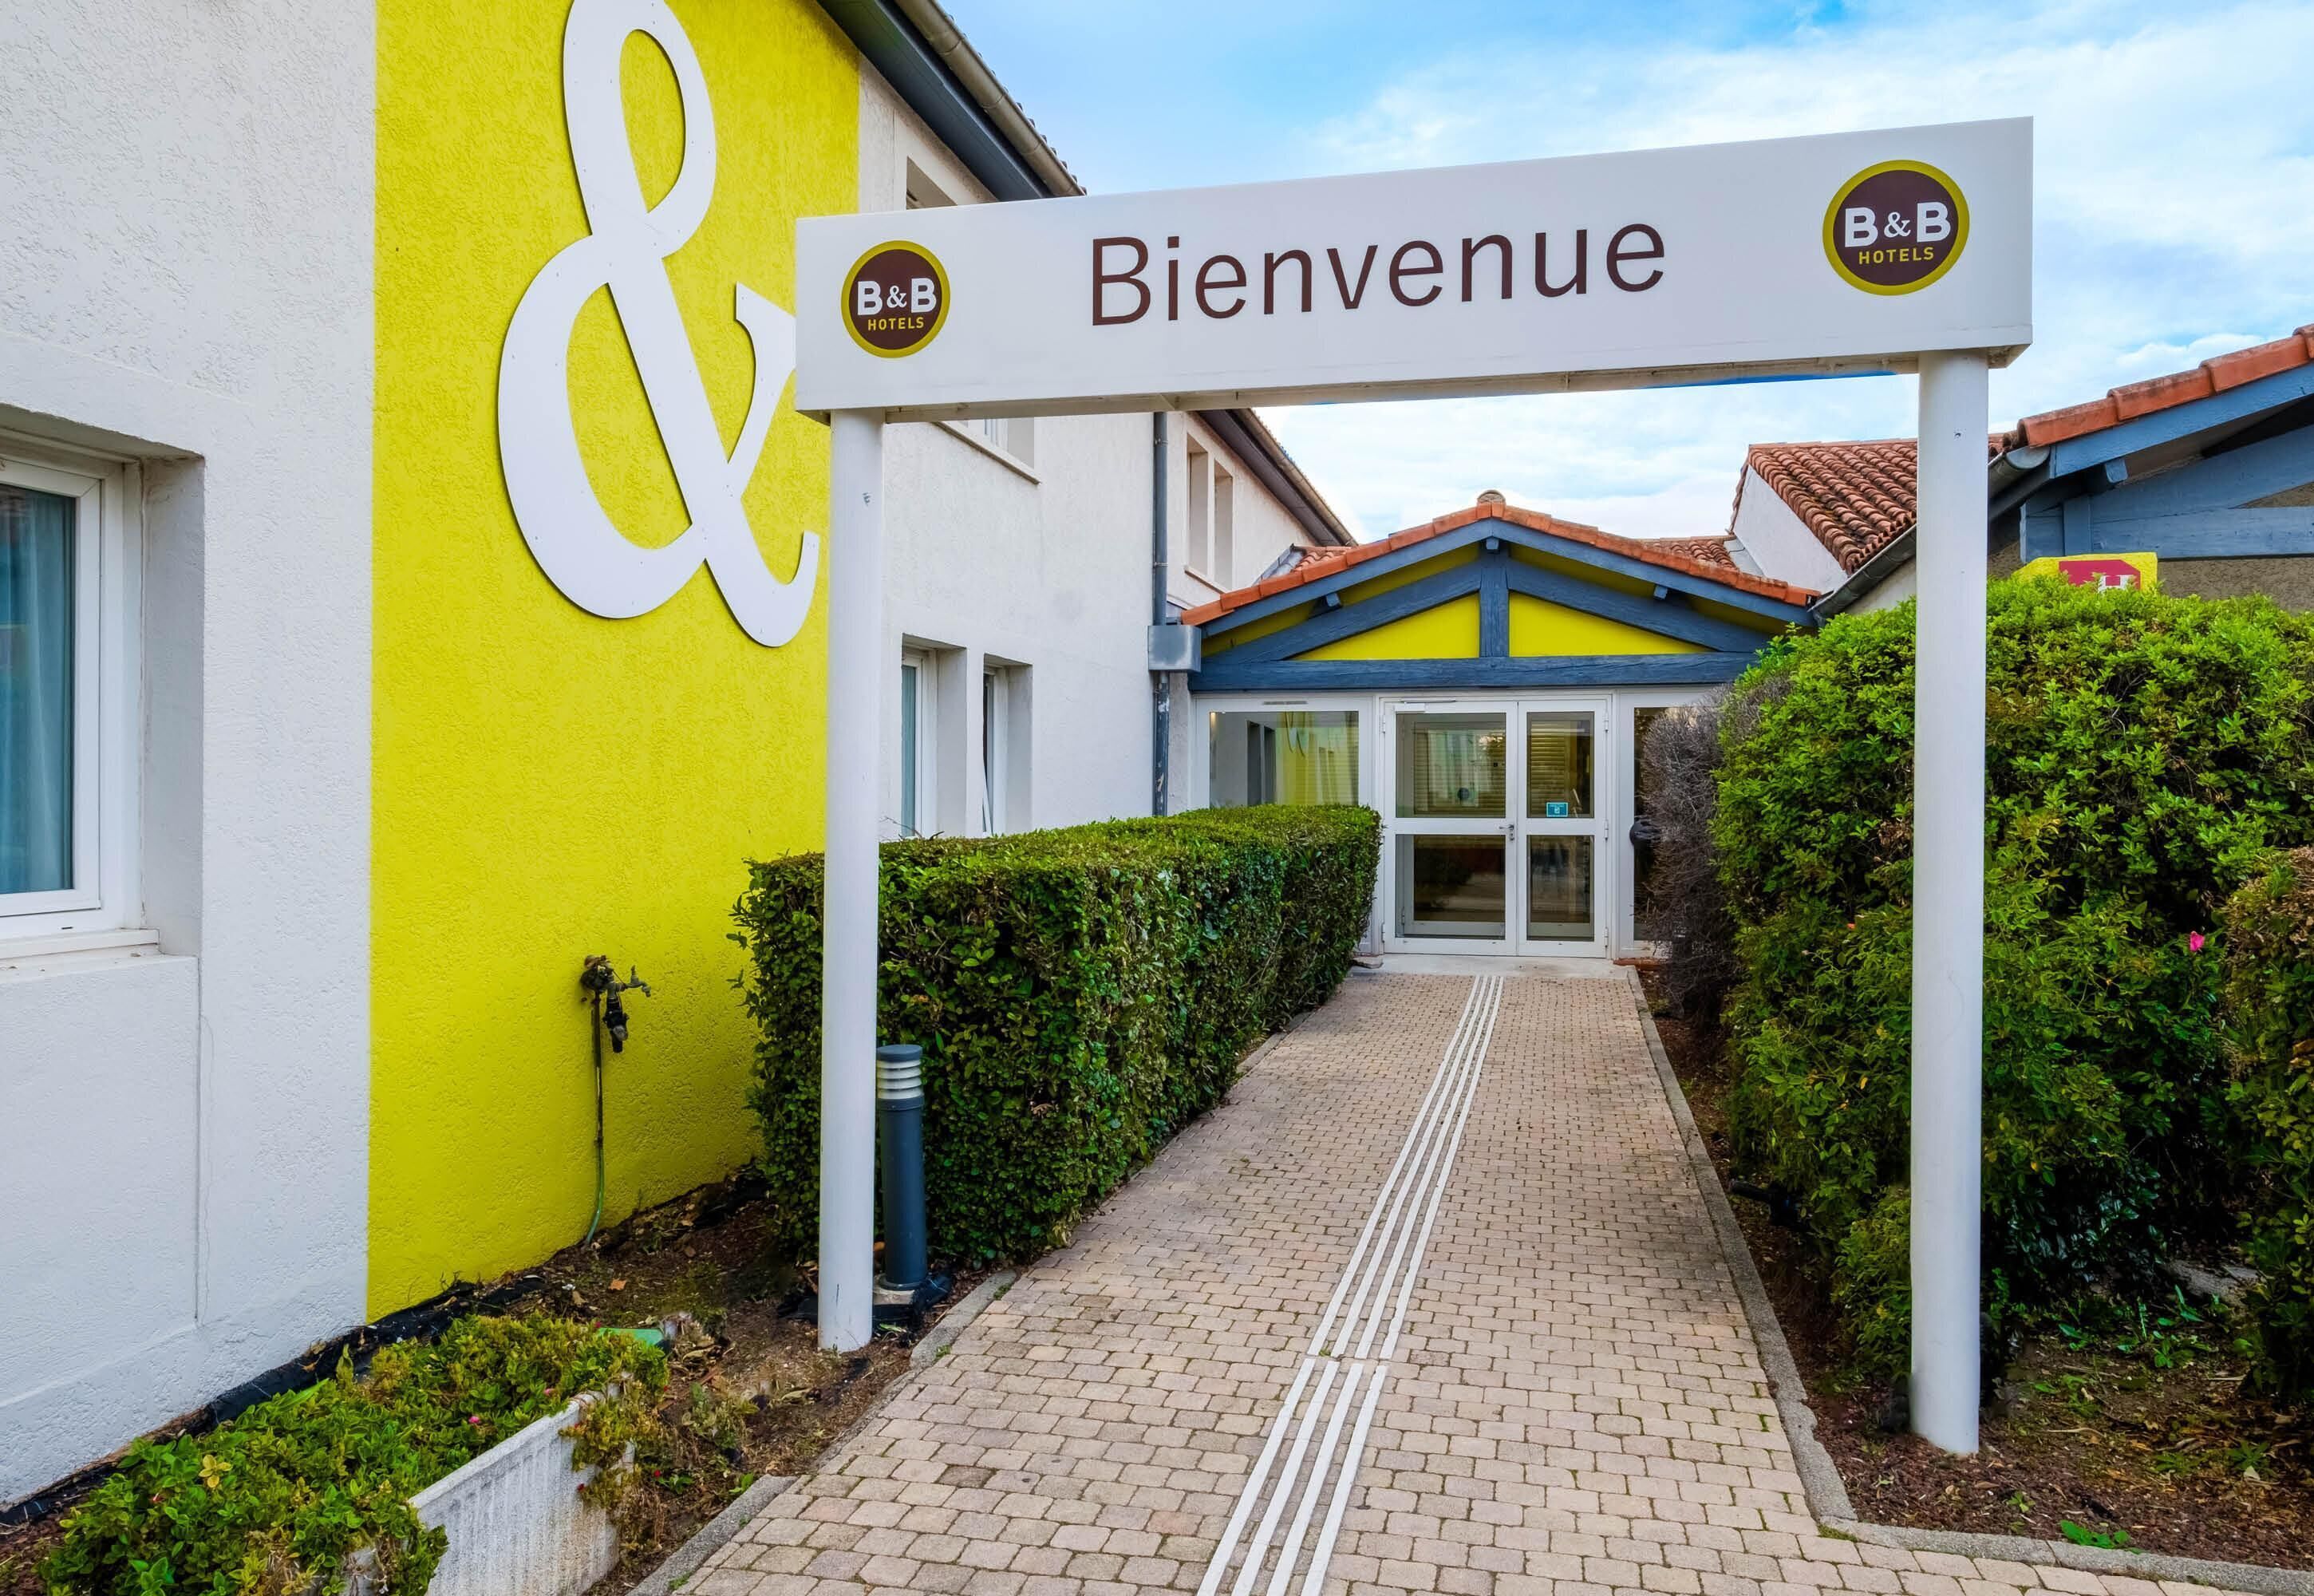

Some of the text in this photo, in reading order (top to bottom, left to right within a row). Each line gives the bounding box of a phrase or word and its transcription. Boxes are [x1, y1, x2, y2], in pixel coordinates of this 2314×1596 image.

[1844, 201, 1952, 247] B&B
[1092, 223, 1665, 326] Bienvenue
[1858, 246, 1935, 265] HOTELS
[857, 277, 937, 316] B&B
[498, 0, 819, 647] &
[867, 316, 925, 331] HOTELS
